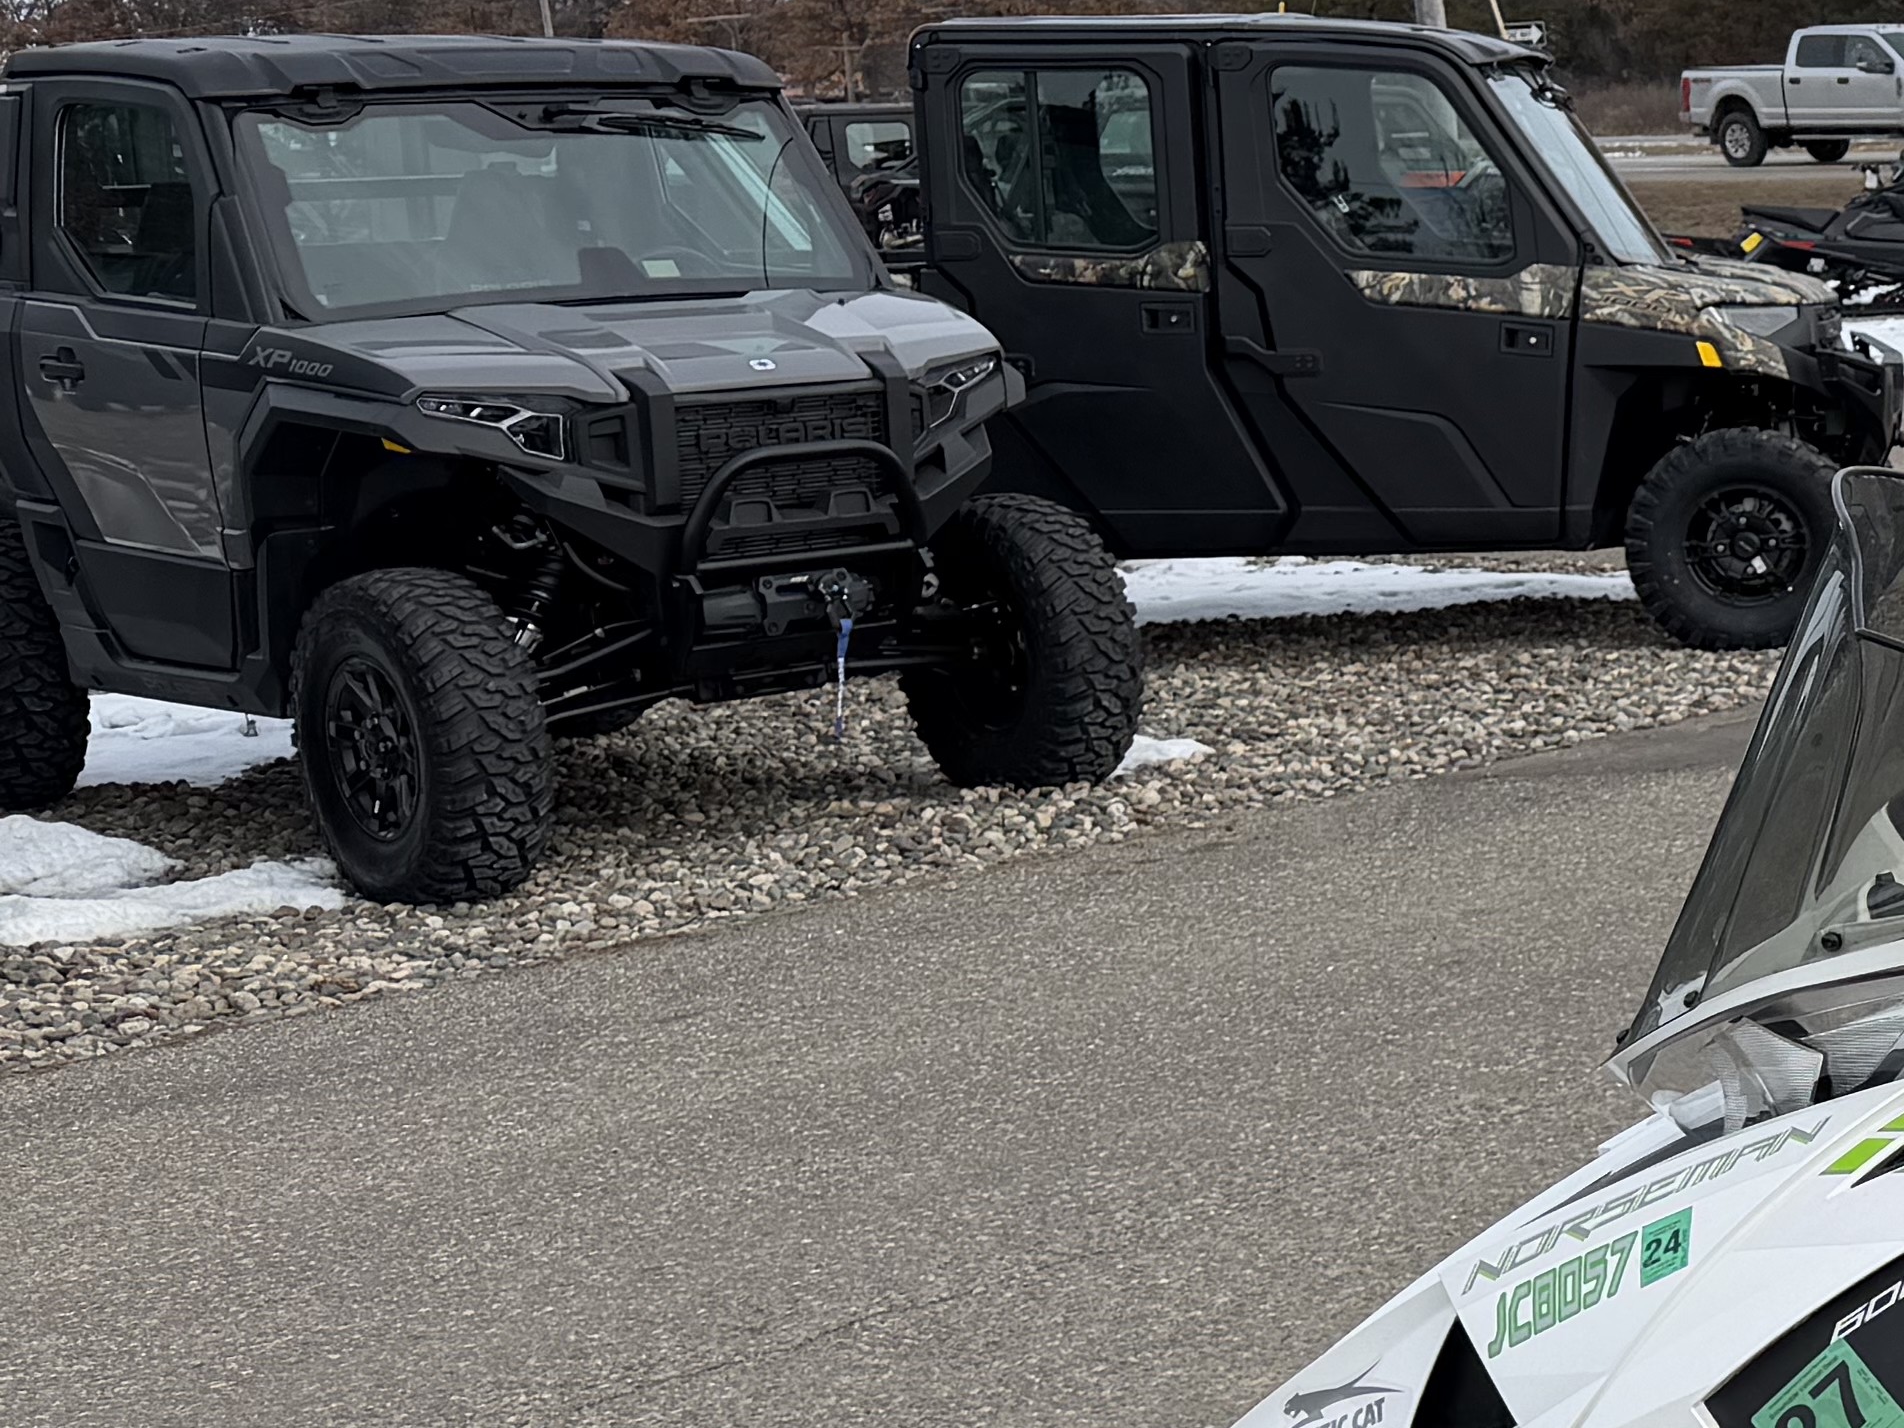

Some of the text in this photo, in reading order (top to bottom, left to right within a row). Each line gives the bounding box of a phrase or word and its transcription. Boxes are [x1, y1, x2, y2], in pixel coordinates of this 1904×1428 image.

[248, 346, 334, 377] XP 1000
[699, 417, 867, 452] POLARIS
[1461, 1115, 1832, 1296] NORSEMAN
[1642, 1228, 1682, 1269] 24
